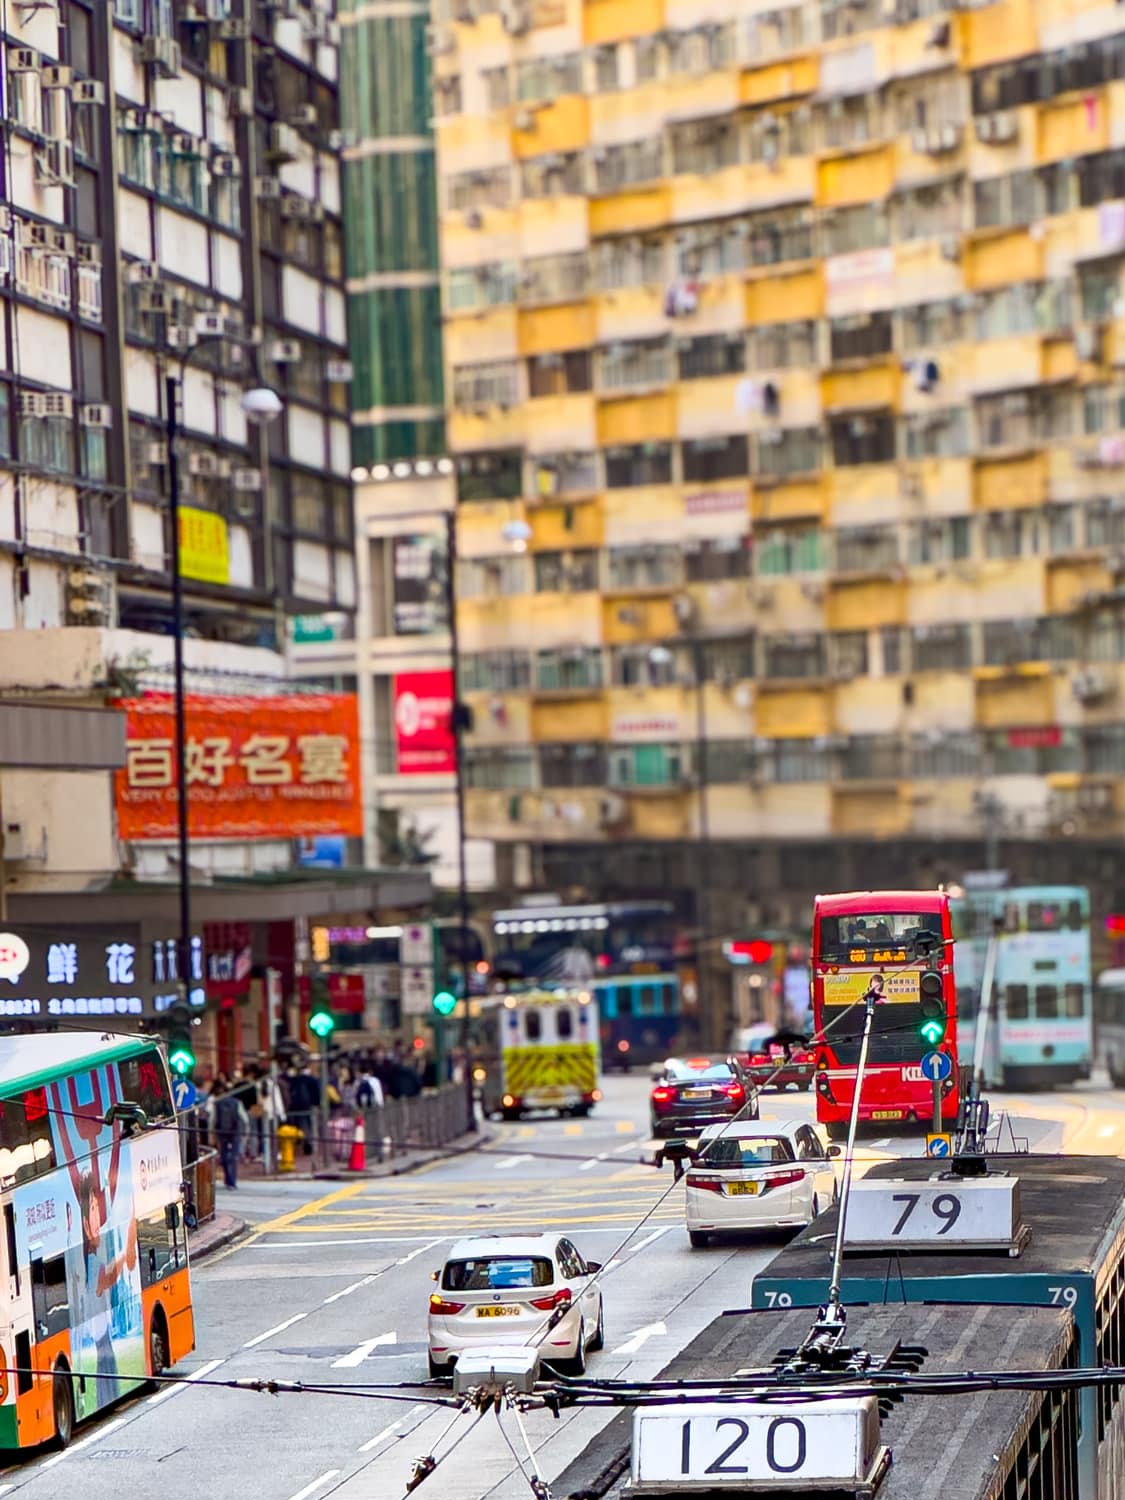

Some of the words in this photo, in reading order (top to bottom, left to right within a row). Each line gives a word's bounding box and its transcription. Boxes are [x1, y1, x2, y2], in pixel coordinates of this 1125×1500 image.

[891, 1193, 962, 1235] 79
[764, 1291, 792, 1308] 79
[1048, 1286, 1078, 1309] 79
[681, 1417, 807, 1475] 120
